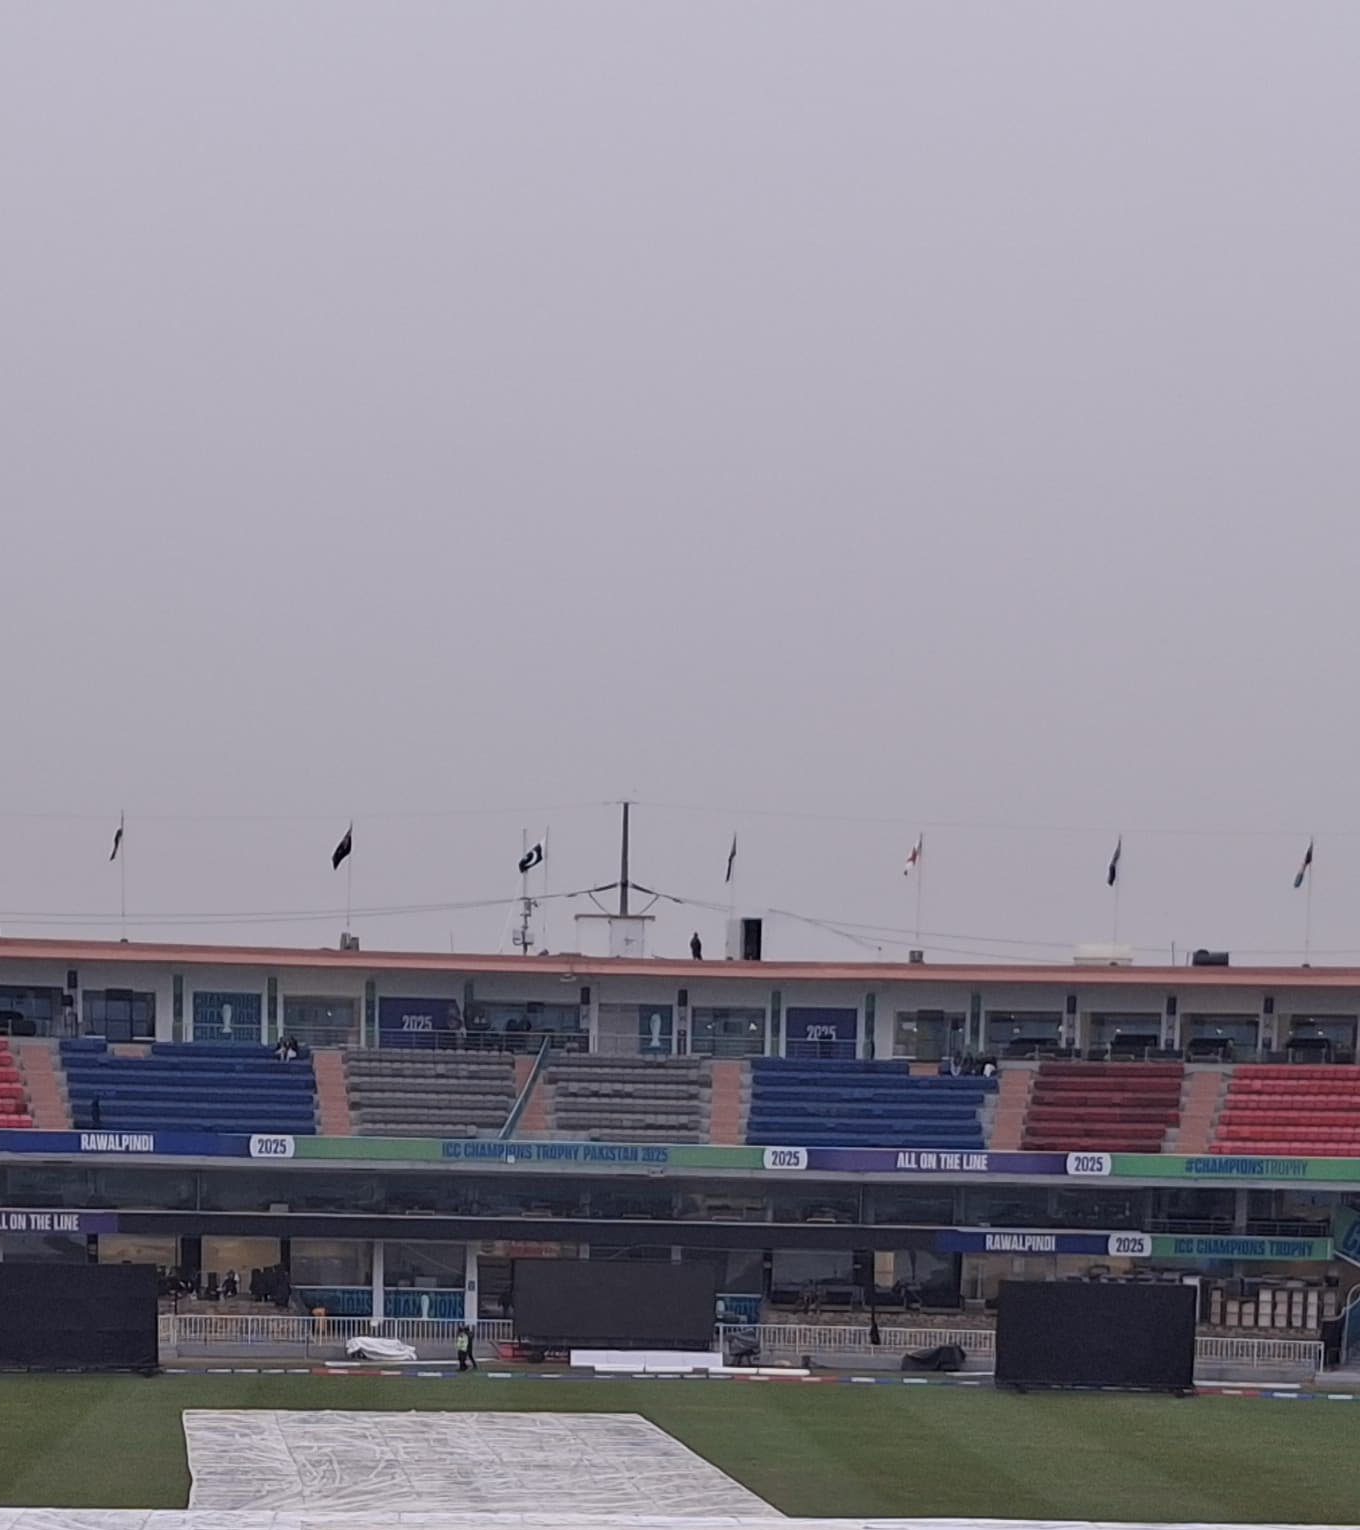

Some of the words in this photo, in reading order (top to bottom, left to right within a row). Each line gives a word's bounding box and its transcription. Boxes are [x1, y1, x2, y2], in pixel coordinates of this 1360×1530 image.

[402, 1015, 433, 1031] 2025
[81, 1133, 154, 1152] RAWALPINDI
[257, 1138, 287, 1154] 2025
[442, 1142, 461, 1158] ICC
[464, 1142, 532, 1160] CHAMPIONS
[534, 1144, 578, 1161] TROPHY
[583, 1145, 638, 1162] PAKISTAN
[641, 1147, 668, 1162] 2025
[771, 1150, 800, 1167] 2025
[896, 1152, 918, 1168] ALL
[920, 1153, 937, 1169] ON
[939, 1154, 960, 1170] THE
[963, 1154, 988, 1170] LINE
[1074, 1156, 1103, 1172] 2025
[10, 1214, 27, 1230] ON
[29, 1214, 51, 1231] THE
[53, 1214, 80, 1231] LINE
[986, 1234, 1056, 1251] RAWALPINDI
[1115, 1237, 1145, 1253] 2025
[1174, 1238, 1194, 1255] ICC
[1197, 1239, 1266, 1256] CHAMPIONS
[1268, 1240, 1314, 1257] TROPHY
